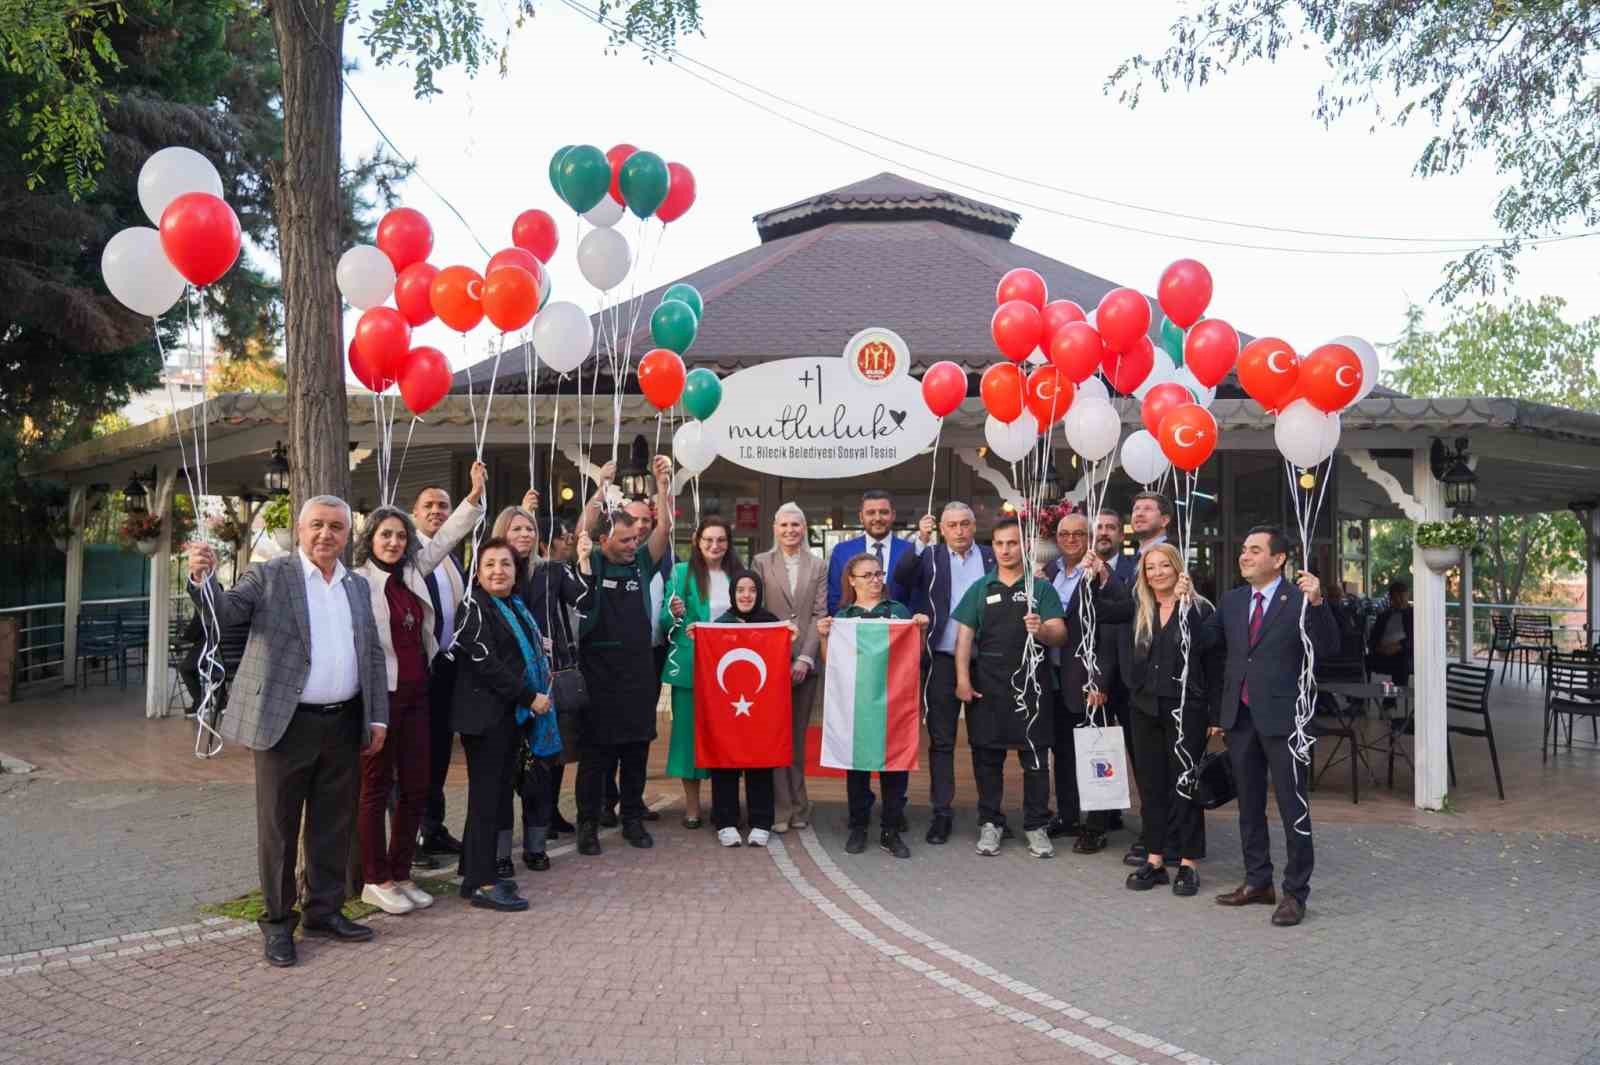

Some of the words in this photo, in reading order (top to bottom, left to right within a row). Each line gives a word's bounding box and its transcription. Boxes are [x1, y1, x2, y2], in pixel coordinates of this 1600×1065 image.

[729, 404, 892, 440] mutluluk
[739, 445, 755, 459] T.C.
[757, 445, 787, 459] Bilecik
[789, 445, 836, 460] Belediyesi
[837, 445, 868, 460] Sosyal
[870, 445, 897, 459] Tesisi
